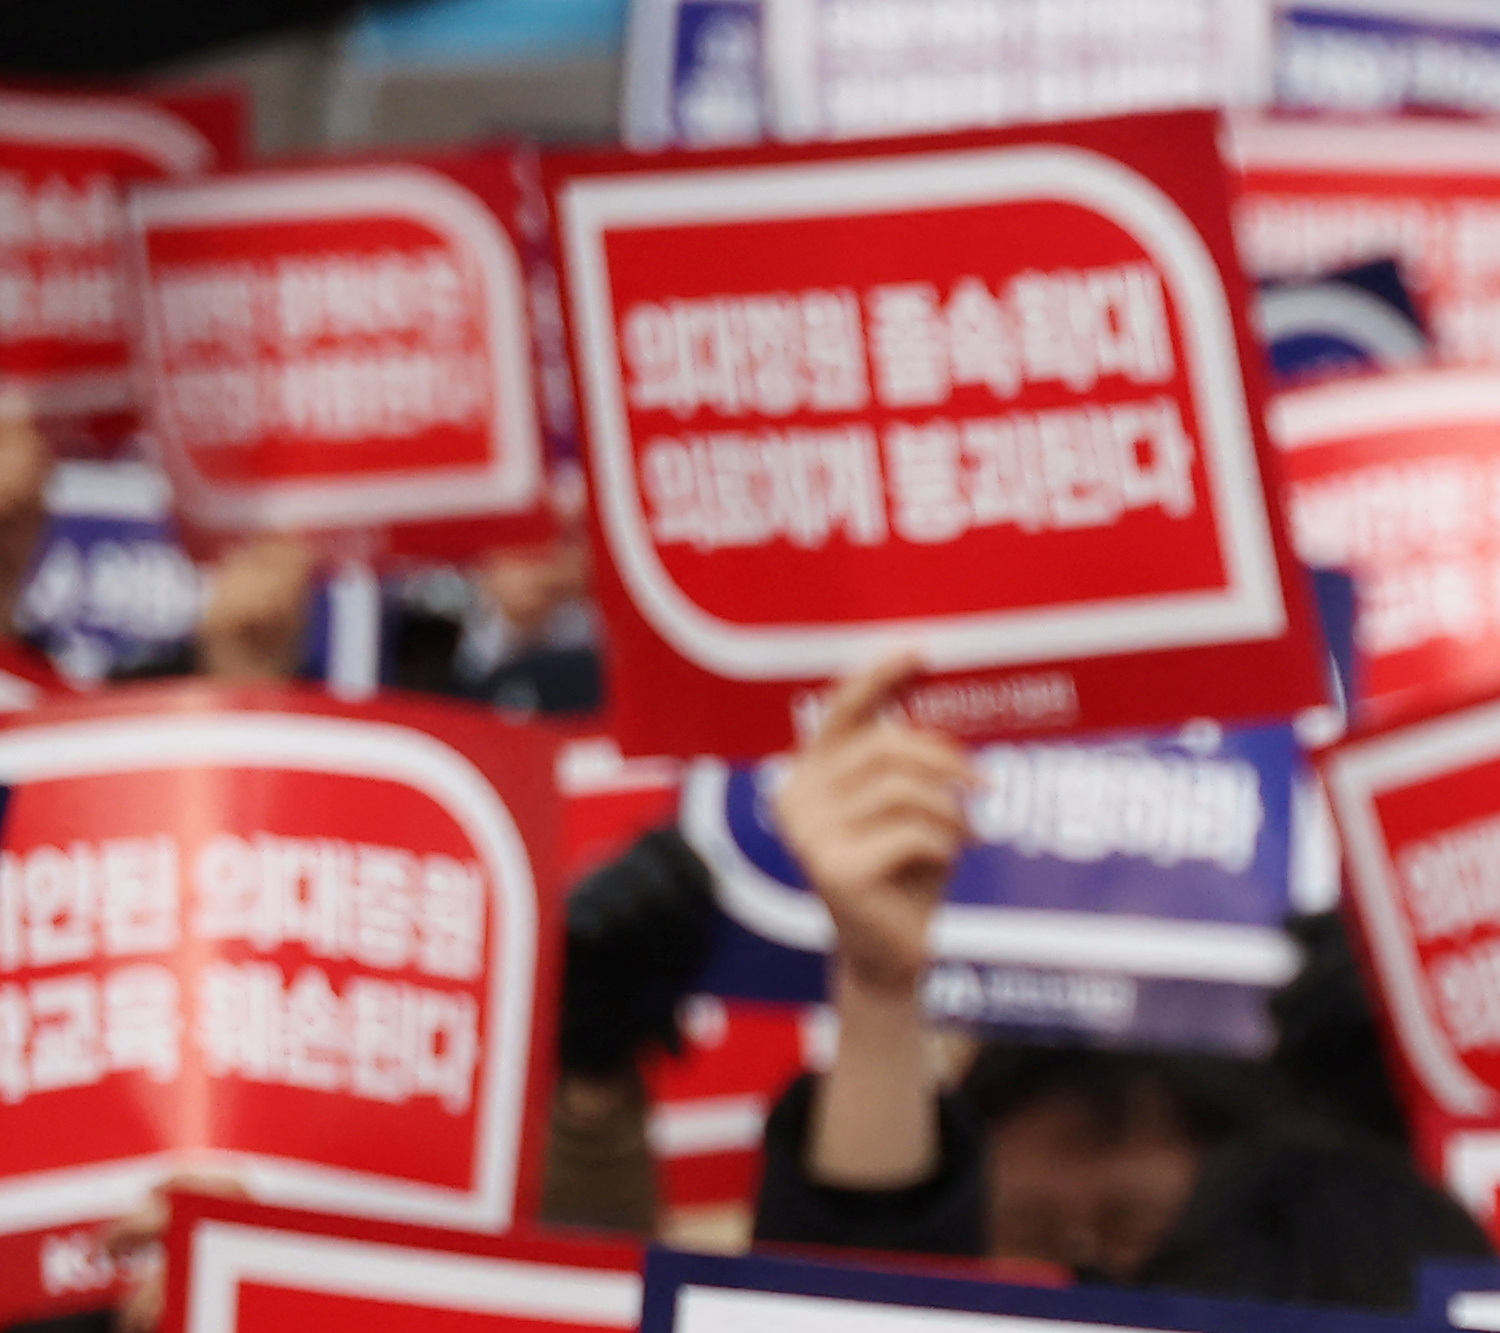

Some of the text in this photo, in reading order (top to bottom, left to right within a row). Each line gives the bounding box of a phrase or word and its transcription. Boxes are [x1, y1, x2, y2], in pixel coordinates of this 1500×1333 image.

[623, 289, 869, 414] 의대정원
[869, 264, 1172, 402] 졸속확대
[645, 398, 1193, 547] 의료체계 붕괴된다
[0, 832, 485, 984] 안된 의대증원
[198, 964, 479, 1116] 훼손된다
